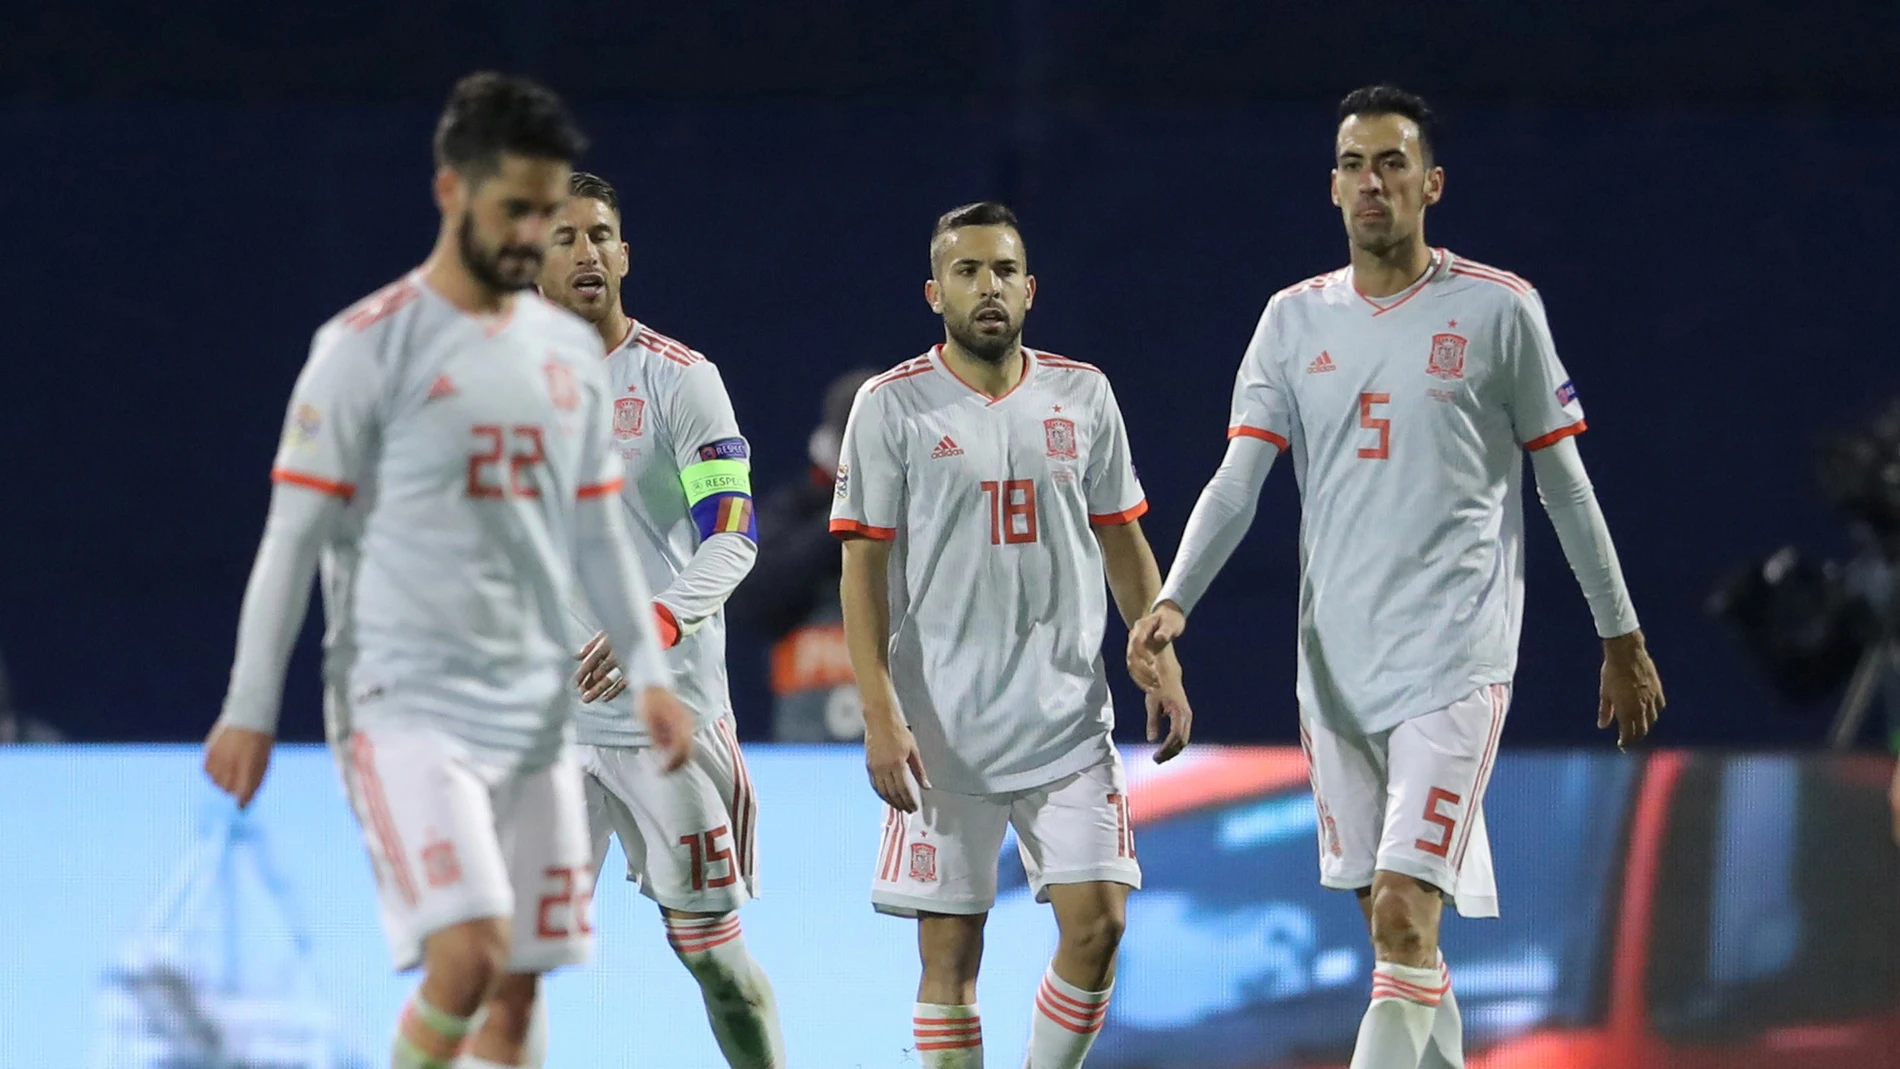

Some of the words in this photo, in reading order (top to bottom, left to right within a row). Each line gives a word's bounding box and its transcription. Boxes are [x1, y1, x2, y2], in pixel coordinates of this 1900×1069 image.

[931, 448, 964, 460] adidas
[1357, 393, 1390, 460] 5
[467, 424, 545, 499] 22
[980, 479, 1036, 545] 18
[1415, 786, 1460, 858] 5
[680, 825, 737, 890] 15
